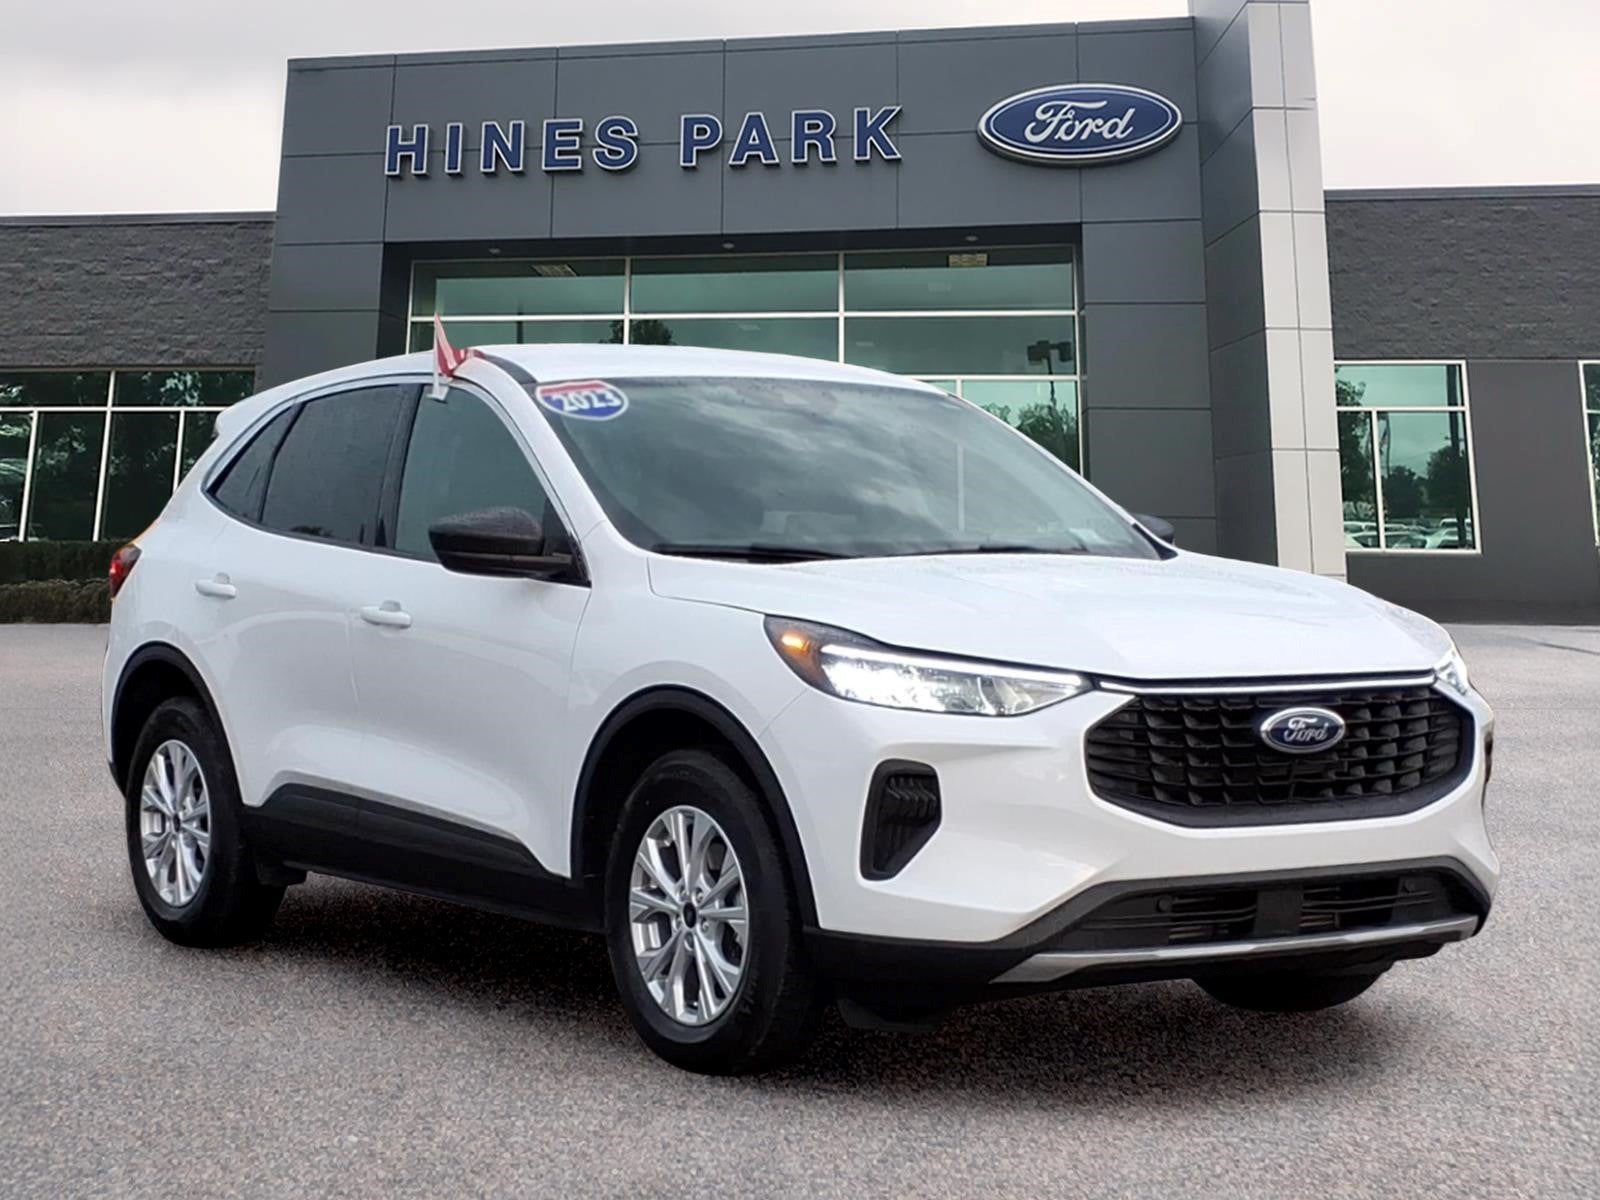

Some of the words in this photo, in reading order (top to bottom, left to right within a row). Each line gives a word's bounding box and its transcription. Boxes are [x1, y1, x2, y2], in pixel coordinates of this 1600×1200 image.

[1024, 100, 1136, 143] Ford
[384, 116, 639, 176] HINES
[679, 105, 903, 168] PARK
[551, 389, 622, 411] 2023
[1283, 717, 1329, 742] Ford
